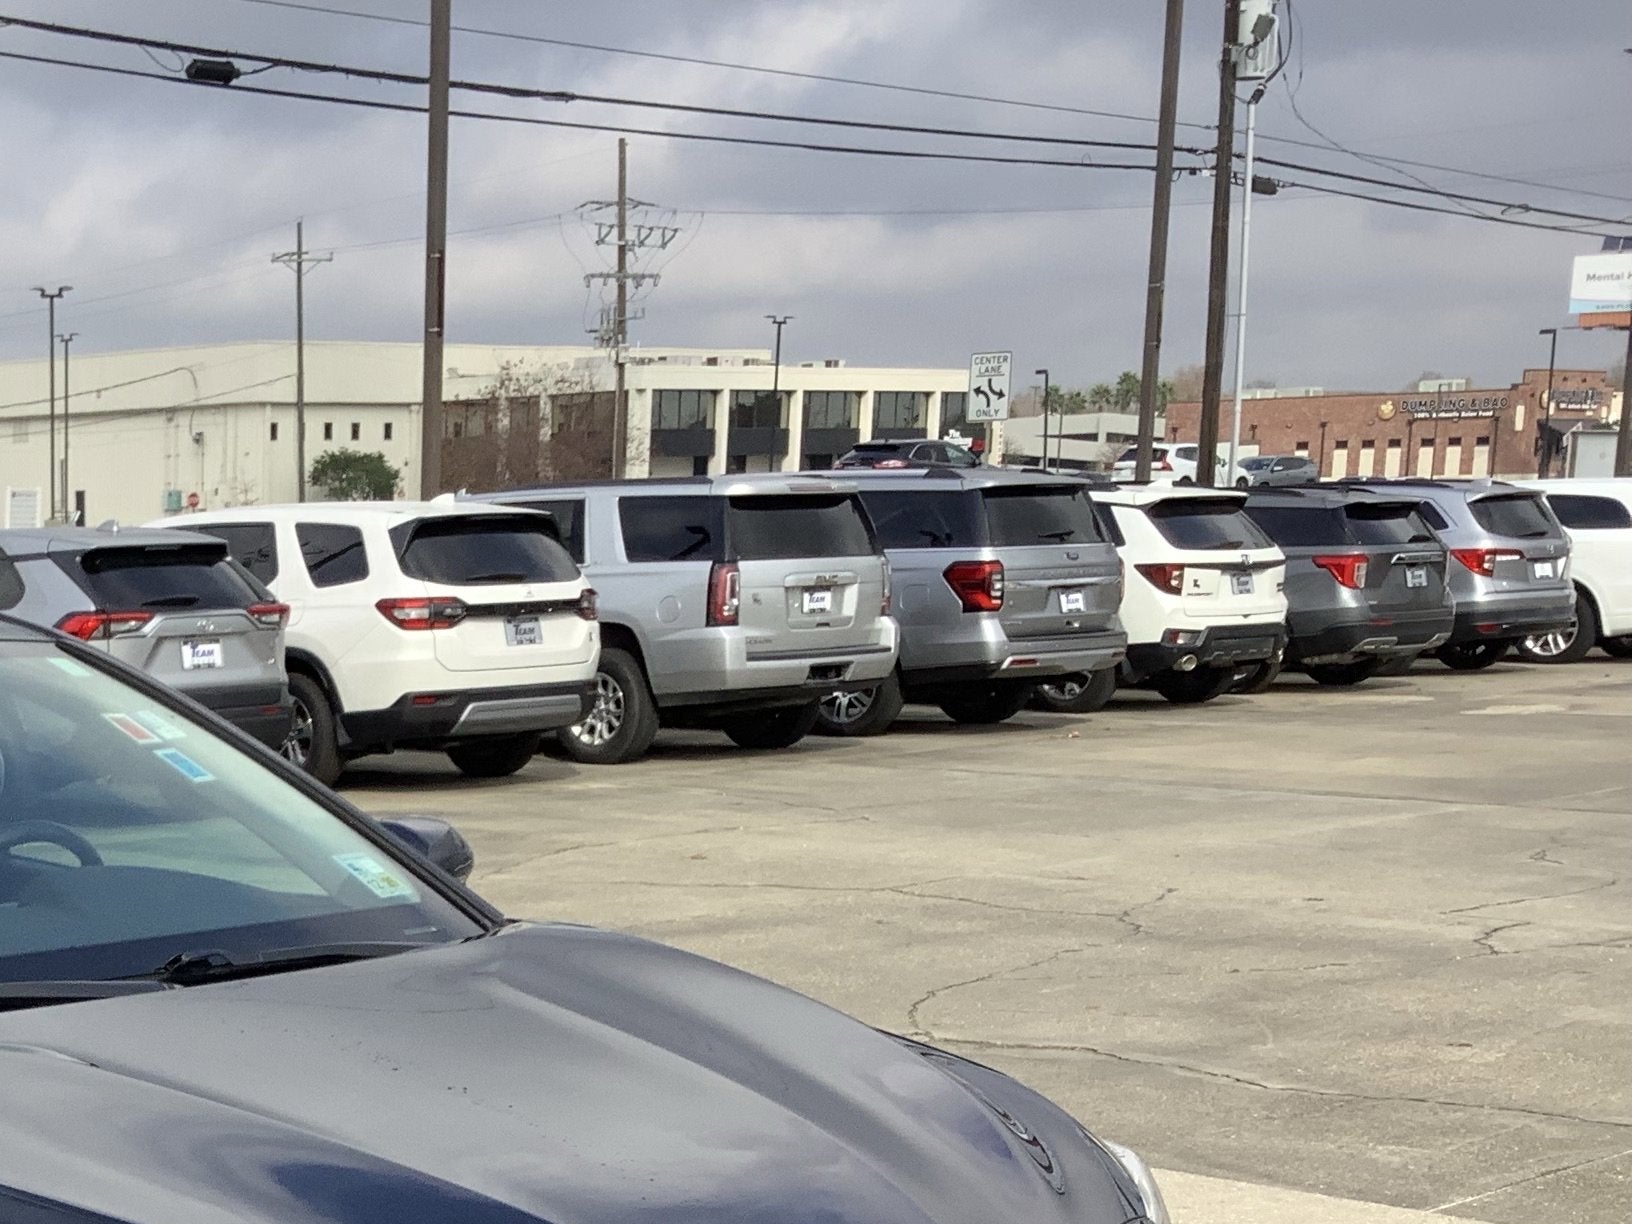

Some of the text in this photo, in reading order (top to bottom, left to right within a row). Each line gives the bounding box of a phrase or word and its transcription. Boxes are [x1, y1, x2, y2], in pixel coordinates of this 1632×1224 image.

[1586, 272, 1625, 281] Mental
[974, 355, 1009, 366] CENTER
[978, 365, 1003, 375] LANE
[1483, 396, 1509, 410] BAO
[975, 408, 1001, 418] ONLY
